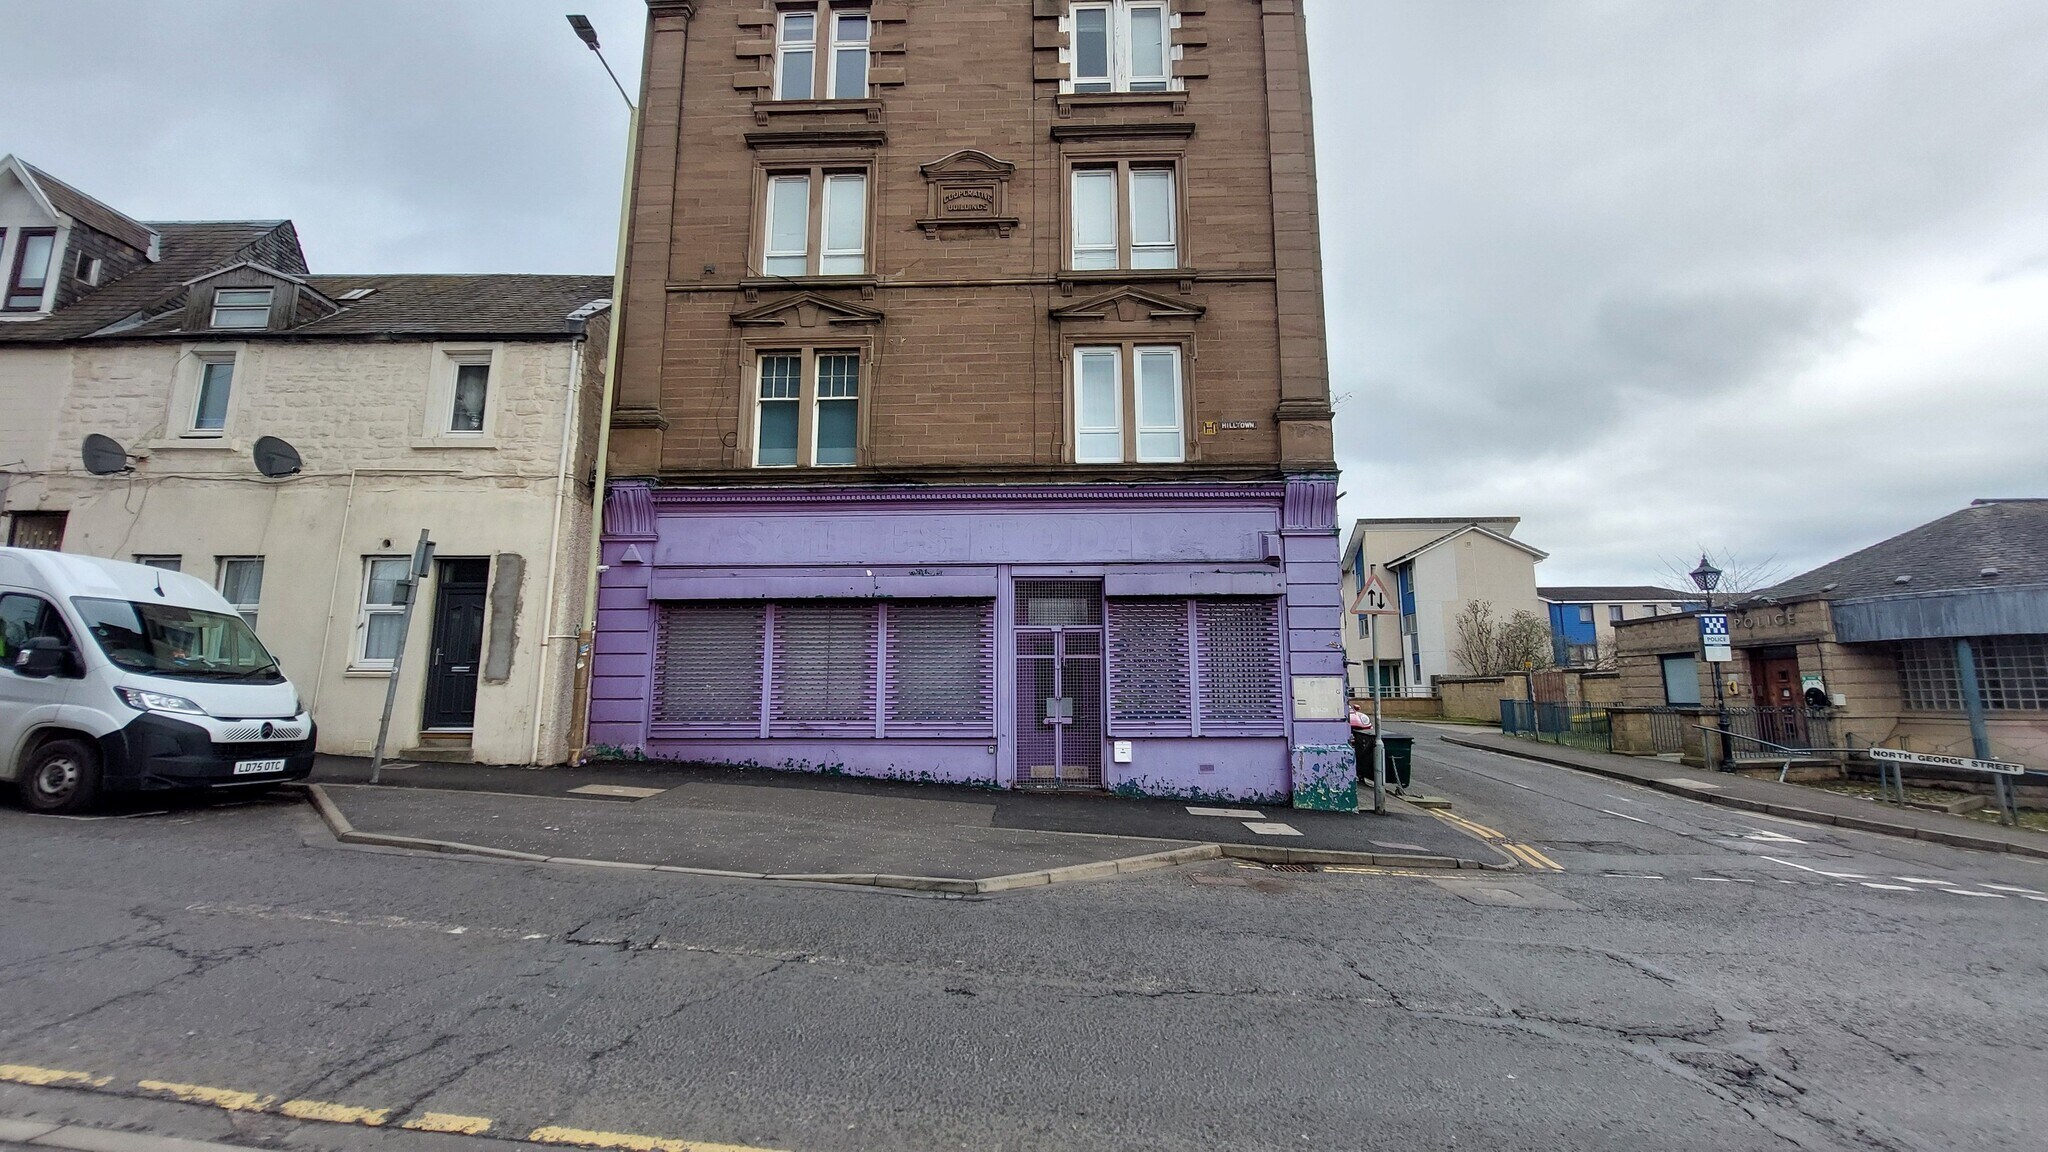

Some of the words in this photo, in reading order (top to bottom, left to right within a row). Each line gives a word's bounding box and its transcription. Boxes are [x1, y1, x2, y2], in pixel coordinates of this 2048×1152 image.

[947, 203, 988, 211] BUILDINGS
[1733, 613, 1795, 629] POLICE
[238, 762, 263, 773] LD75
[264, 761, 281, 771] OTC
[1873, 750, 1912, 760] NORTH
[1918, 754, 1964, 766] GEORGE
[1971, 760, 2020, 773] STREET
